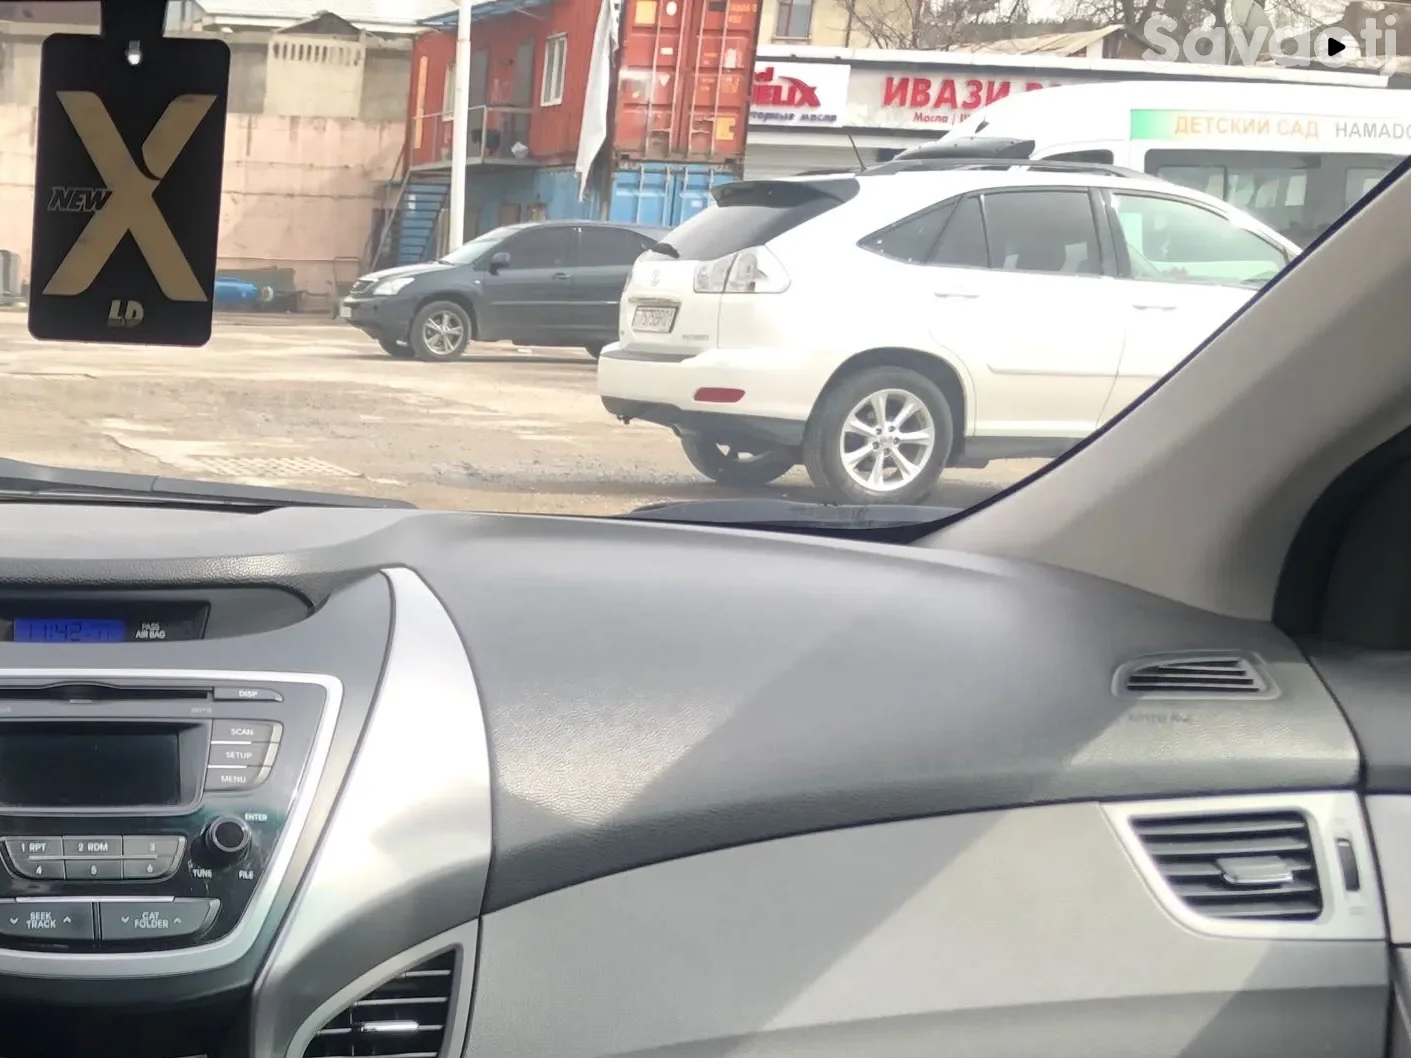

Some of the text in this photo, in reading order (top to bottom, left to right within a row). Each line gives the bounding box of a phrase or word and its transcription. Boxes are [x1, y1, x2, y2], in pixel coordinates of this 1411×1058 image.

[883, 76, 1011, 110] ИВАЗИ
[749, 111, 796, 122] торные
[1277, 119, 1319, 141] САД
[41, 90, 218, 302] X
[47, 187, 113, 212] NEW
[238, 689, 259, 698] DISP
[230, 727, 255, 736] SCAN
[225, 751, 253, 760] SETUP
[220, 774, 247, 784] MENU
[244, 812, 268, 821] ENTER
[29, 842, 47, 852] RPT
[87, 841, 109, 852] RDM
[35, 864, 43, 875] 4
[146, 863, 154, 873] 6
[192, 867, 213, 878] TUNE
[238, 868, 254, 880] FILE
[29, 911, 52, 920] SEEK
[141, 911, 160, 920] CAT
[26, 919, 57, 929] TRACK
[134, 919, 170, 929] FOLDER
